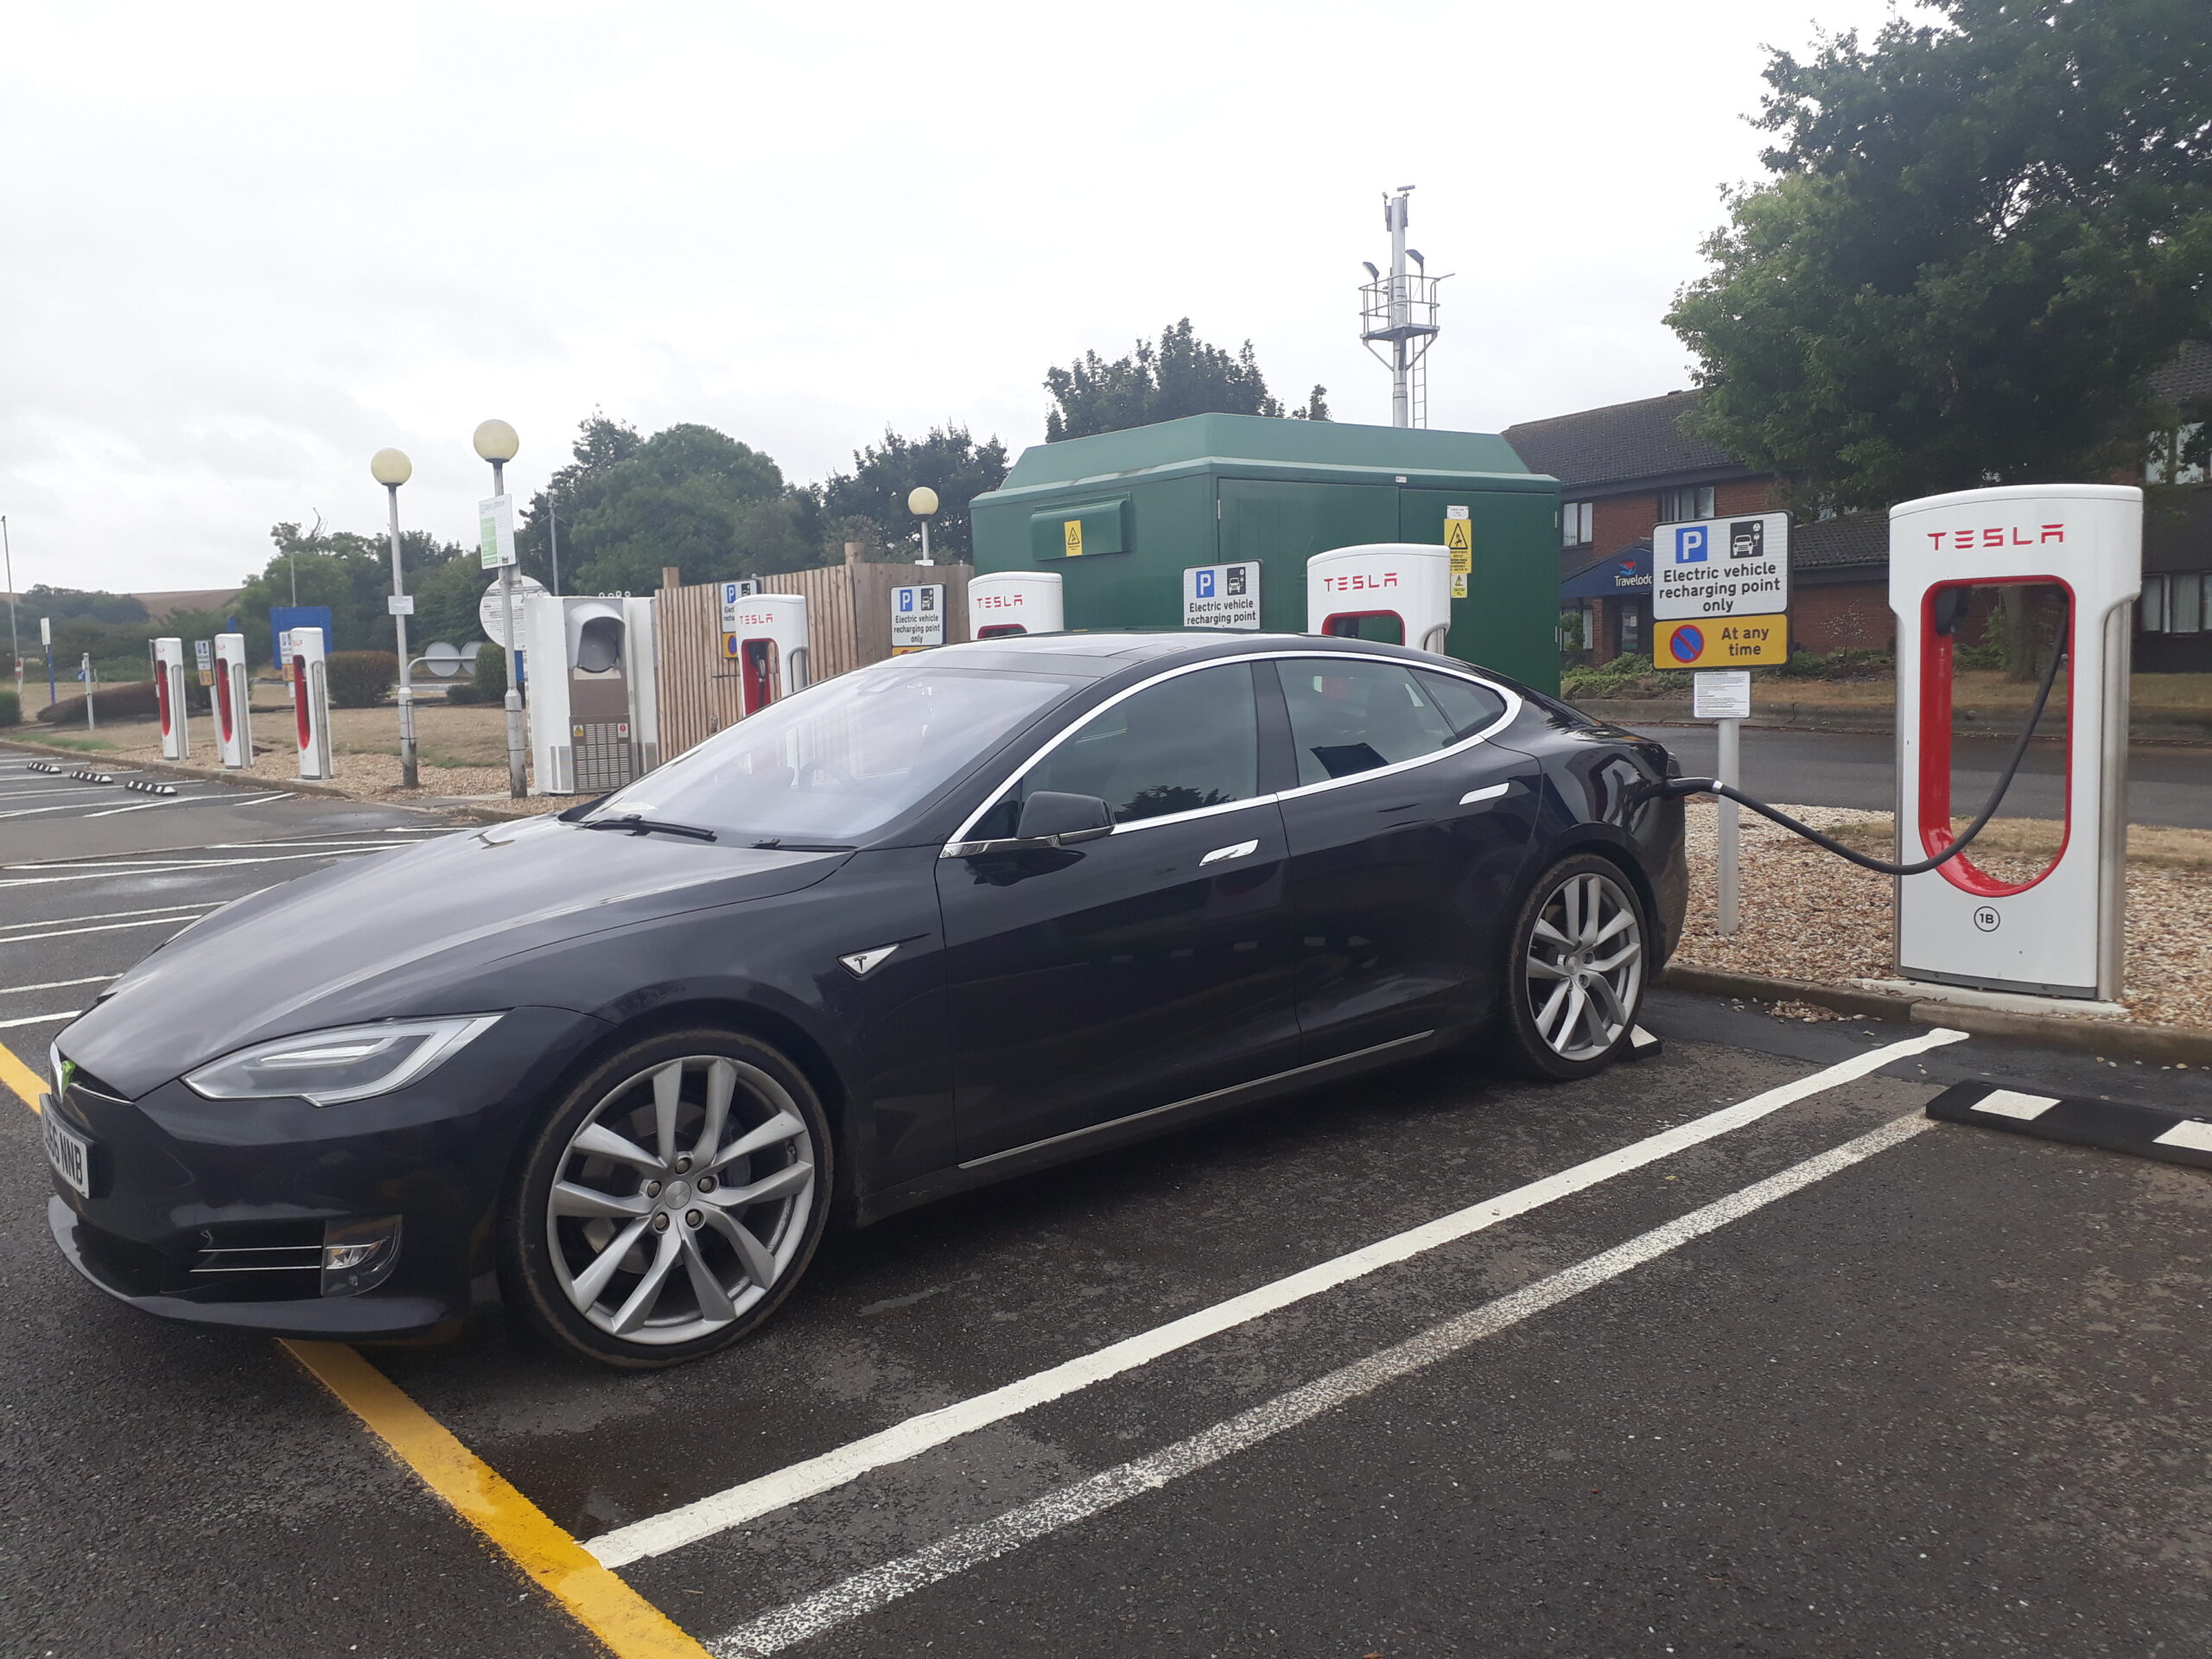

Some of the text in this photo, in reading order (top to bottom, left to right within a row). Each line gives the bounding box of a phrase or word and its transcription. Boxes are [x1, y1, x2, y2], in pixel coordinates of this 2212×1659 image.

[1927, 524, 2064, 550] TESLA
[1682, 531, 1702, 561] P
[1614, 573, 1652, 587] Travelod
[1663, 562, 1777, 583] Electric vehicle
[1323, 573, 1397, 592] TESLA
[1659, 577, 1781, 599] recharging point
[976, 594, 1023, 608] TESLA
[1189, 598, 1254, 613] Electric vehicle
[1702, 598, 1734, 613] only
[740, 613, 773, 625] TESLA
[895, 613, 938, 623] Electric vehicle
[1186, 610, 1256, 626] recharging point
[893, 623, 940, 634] recharging point
[1721, 626, 1770, 641] At any
[911, 634, 923, 644] only
[1728, 643, 1761, 657] time
[1979, 912, 1994, 924] 1B
[60, 1131, 83, 1186] NNB
